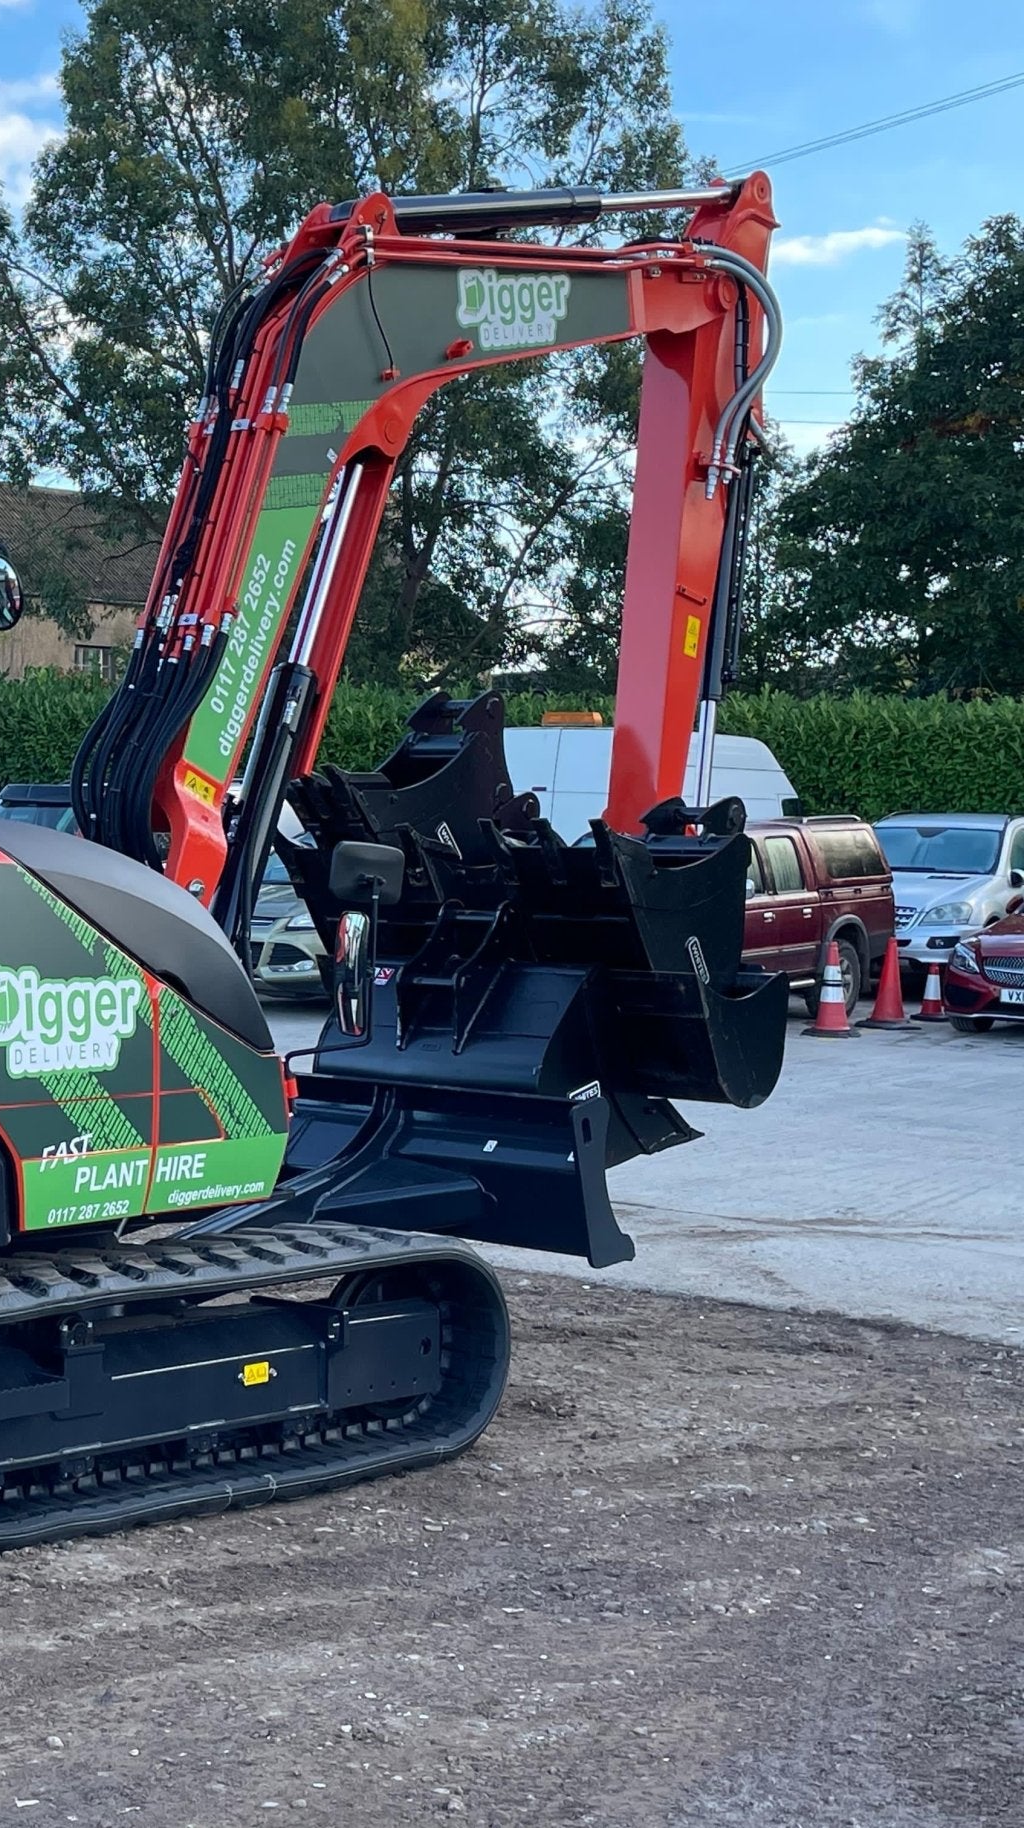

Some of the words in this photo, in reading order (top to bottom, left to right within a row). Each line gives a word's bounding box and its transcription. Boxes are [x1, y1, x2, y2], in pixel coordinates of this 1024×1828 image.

[463, 273, 565, 325] Digger
[483, 323, 553, 342] DELIVERY
[210, 657, 236, 714] 0117
[229, 610, 250, 658] 287
[244, 553, 271, 612] 2652
[218, 539, 296, 756] diggerdelivery.com
[1008, 990, 1024, 1002] VX
[14, 1041, 115, 1065] DELIVERY
[39, 1132, 94, 1173] FAST
[74, 1159, 149, 1194] PLANT
[155, 1153, 207, 1183] HIRE
[167, 1181, 265, 1206] diggerdelivery.com
[47, 1206, 77, 1224] 0117
[78, 1203, 101, 1220] 287
[101, 1199, 130, 1217] 2652
